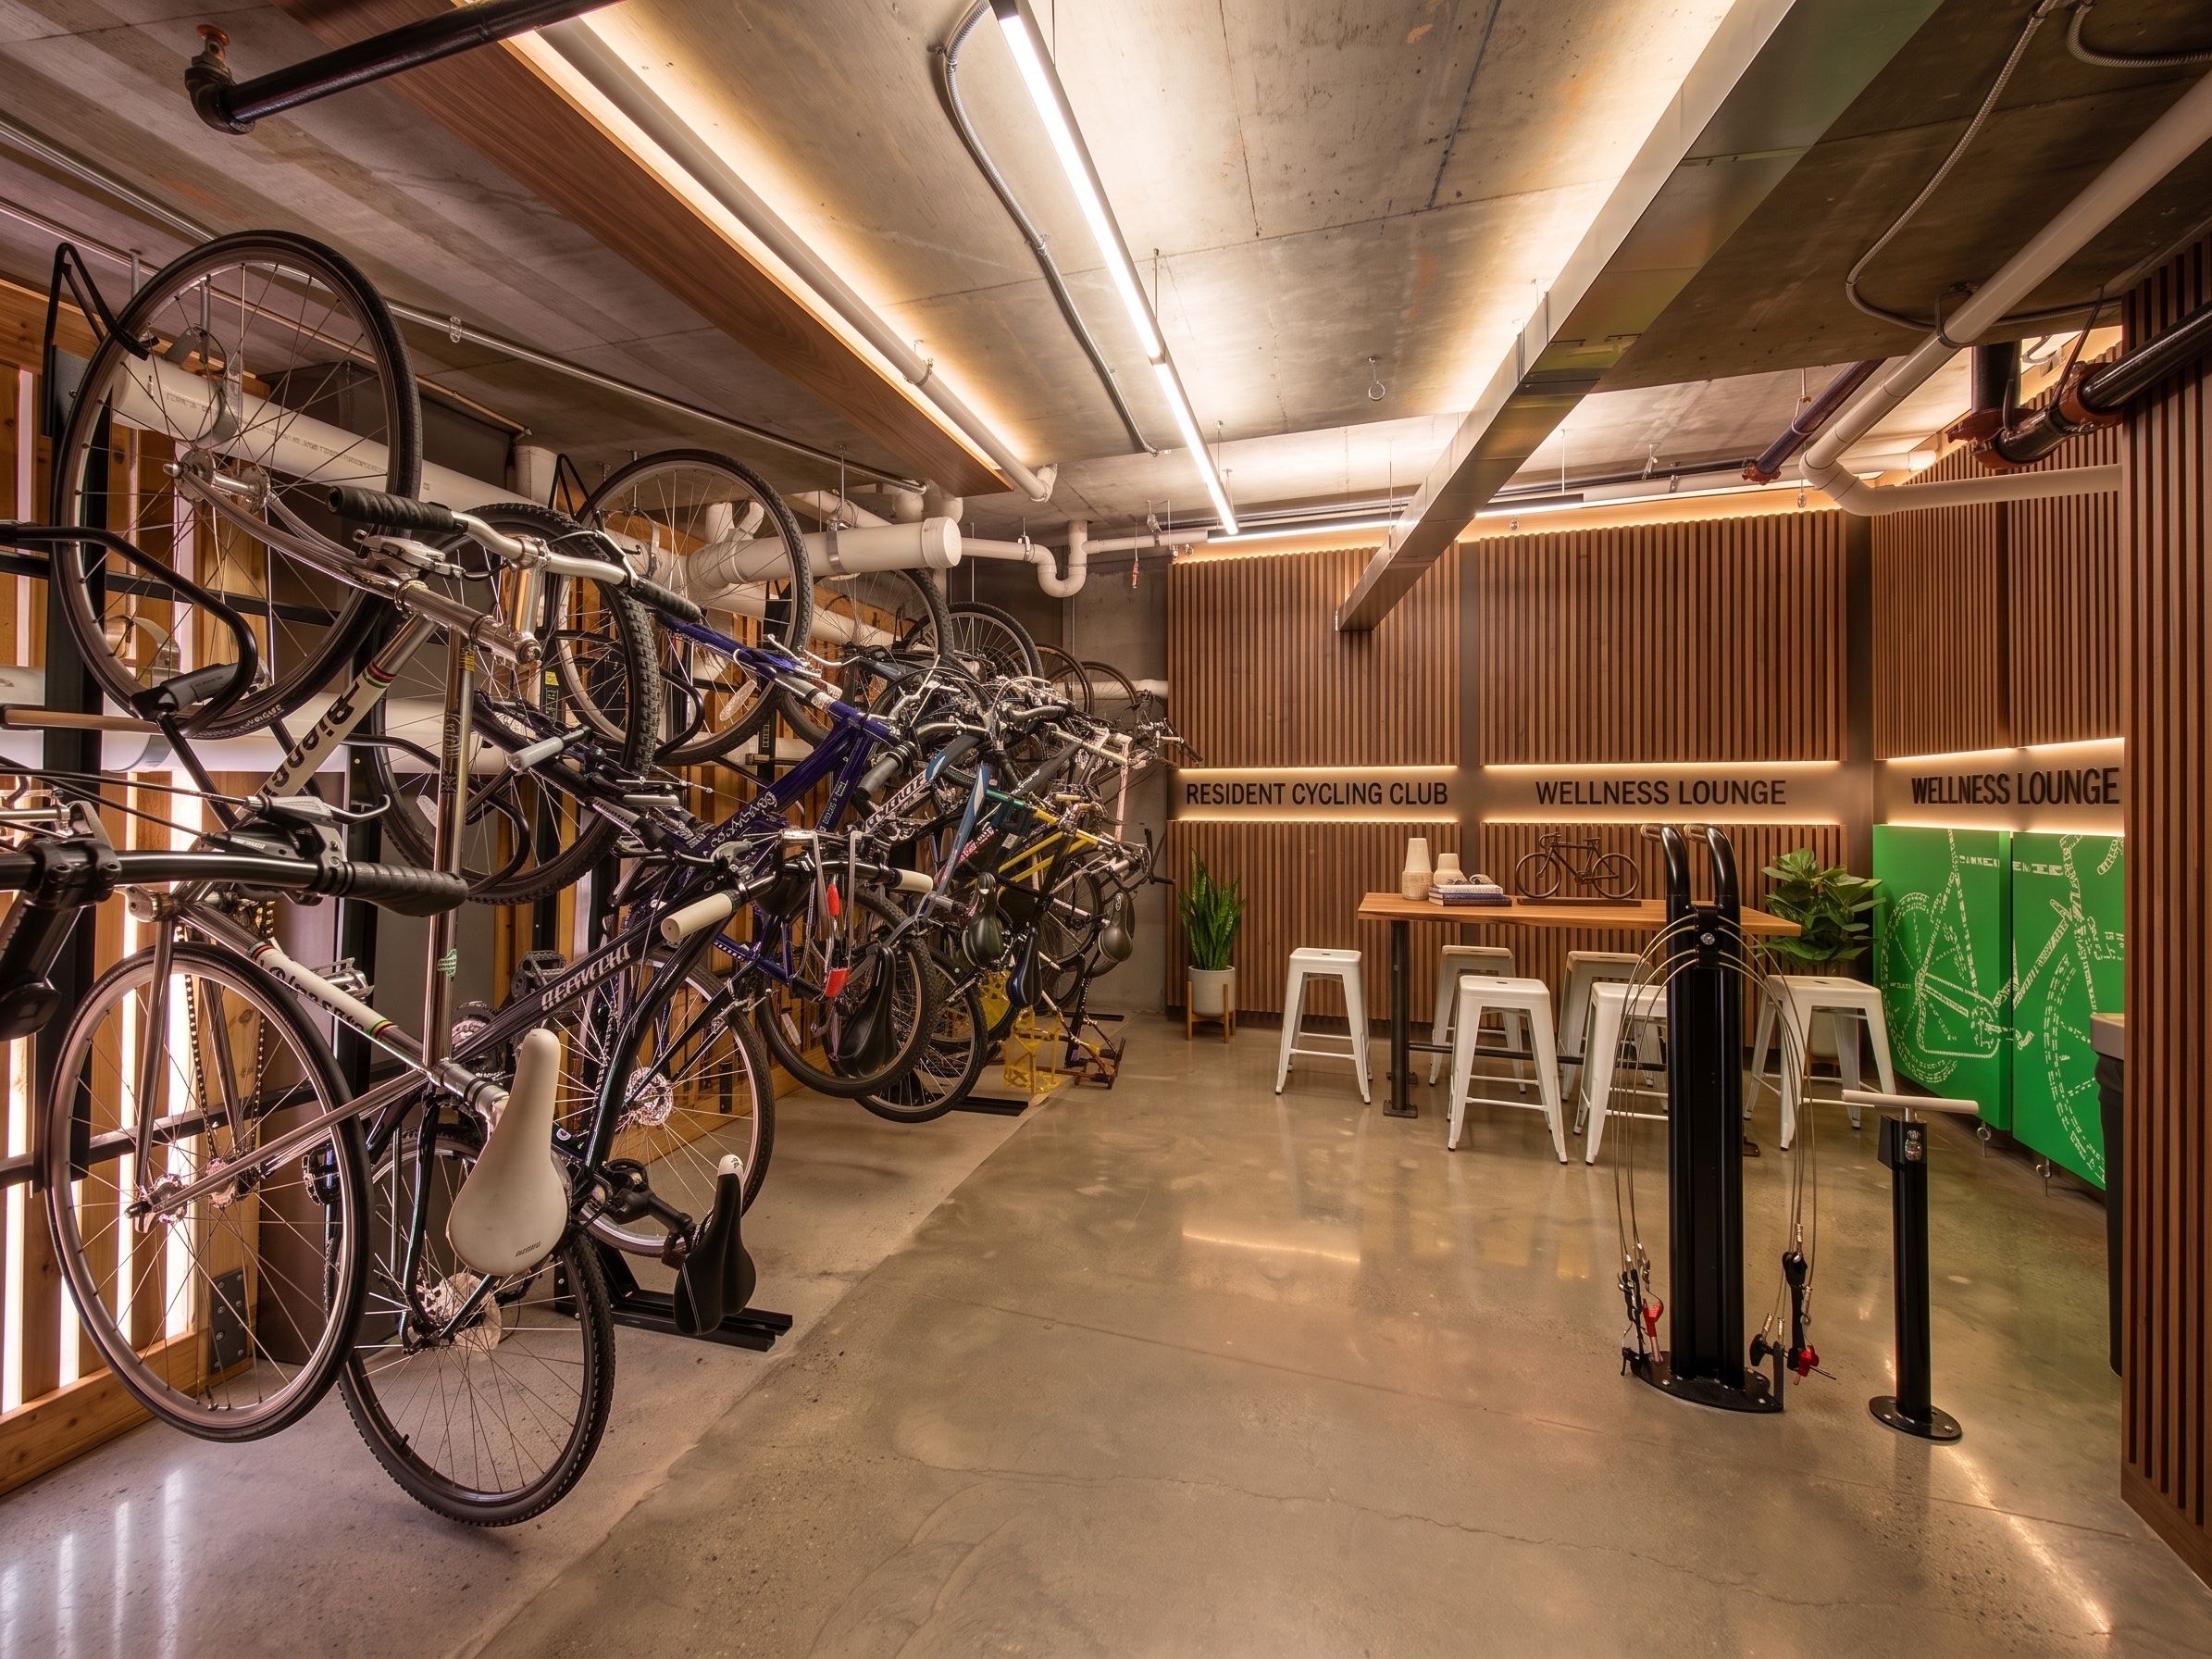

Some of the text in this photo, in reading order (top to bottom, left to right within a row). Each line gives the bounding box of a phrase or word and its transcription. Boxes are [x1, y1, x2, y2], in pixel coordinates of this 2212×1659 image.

[1186, 781, 1448, 805] RESIDENT CYCLING CLUB
[1535, 780, 1787, 805] WELLNESS LOUNGE
[1910, 767, 2120, 805] WELLNESS LOUNGE
